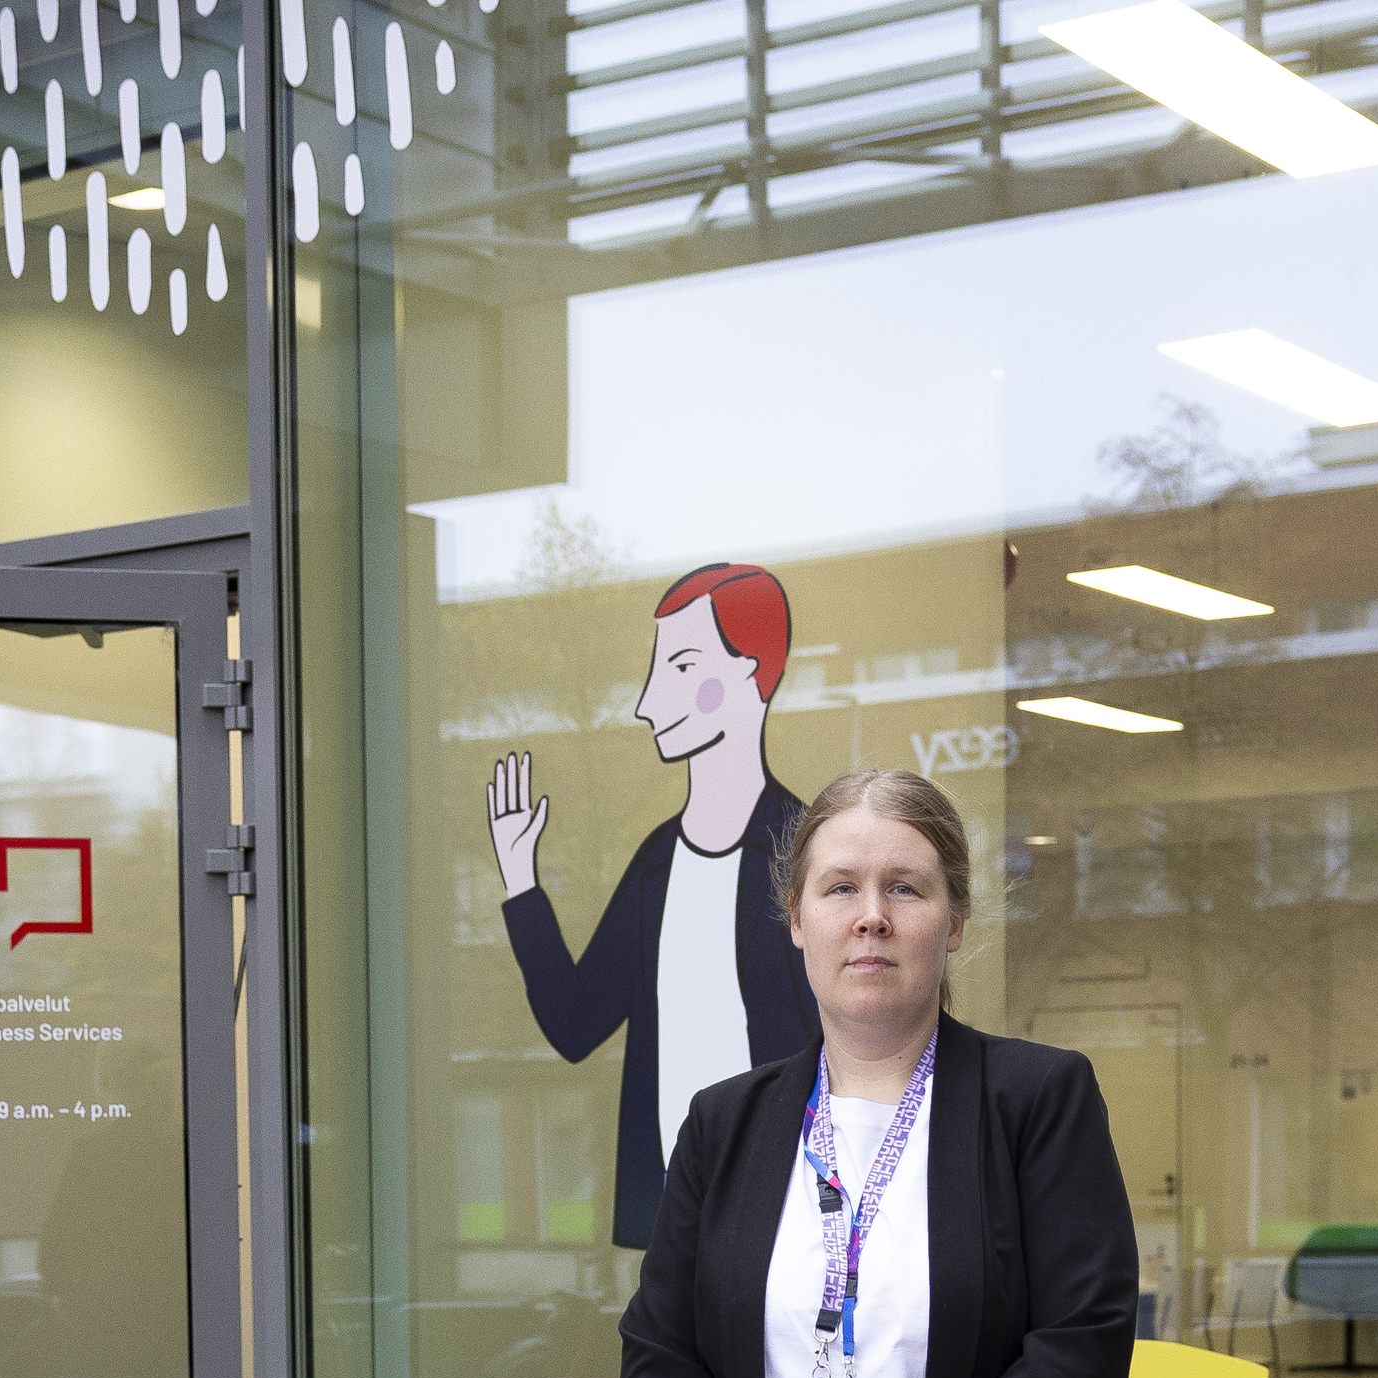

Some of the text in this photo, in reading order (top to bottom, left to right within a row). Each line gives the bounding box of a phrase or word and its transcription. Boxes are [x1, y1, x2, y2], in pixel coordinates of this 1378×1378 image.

[39, 1023, 123, 1042] Services
[13, 1104, 54, 1120] a.m.
[73, 1101, 86, 1119] 4
[90, 1103, 132, 1123] p.m.
